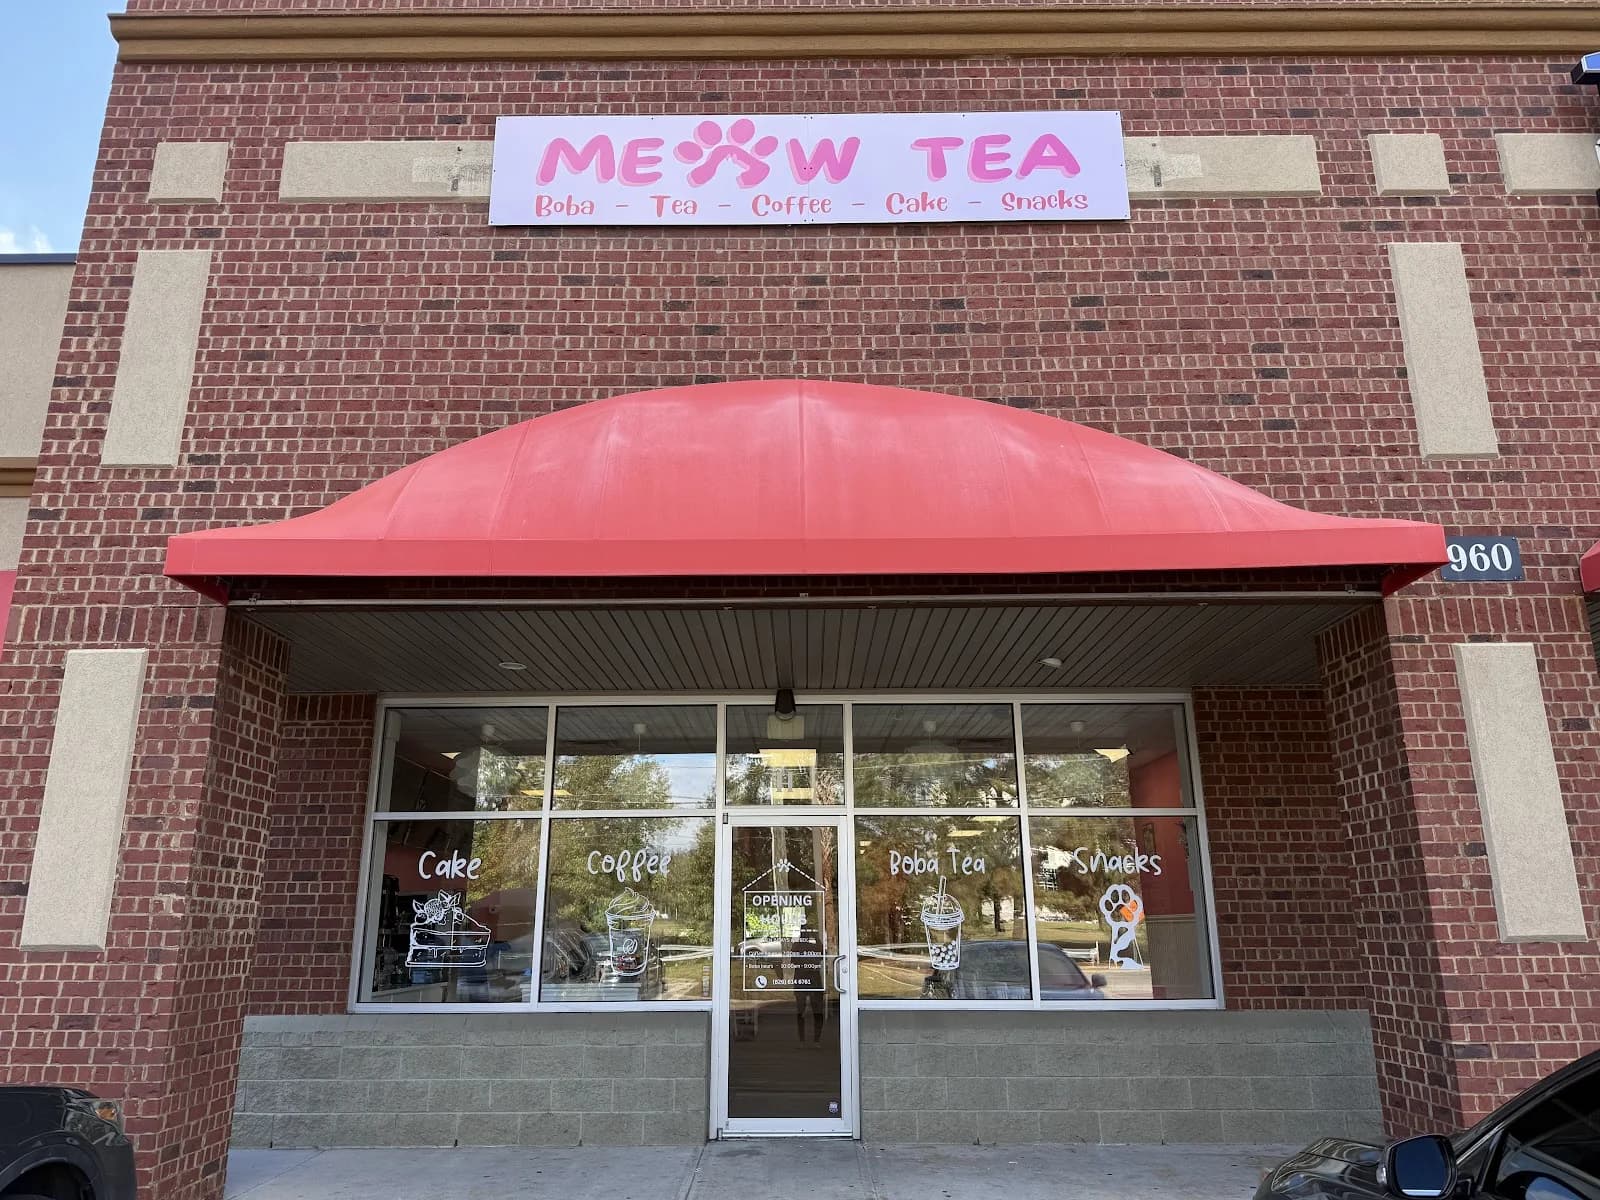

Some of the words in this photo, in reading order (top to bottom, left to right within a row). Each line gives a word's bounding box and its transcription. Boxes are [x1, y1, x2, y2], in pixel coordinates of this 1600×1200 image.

[911, 134, 1081, 183] TEA
[535, 195, 595, 218] Boba
[650, 196, 698, 218] Tea
[752, 195, 832, 217] Coffee
[886, 192, 948, 215] Cake
[1001, 190, 1088, 212] Snacks
[1446, 543, 1513, 572] 960
[418, 850, 482, 879] Cake
[587, 847, 672, 882] Coffee
[889, 849, 939, 876] Boba
[946, 847, 985, 875] Tea
[1073, 847, 1162, 876] Snacks
[752, 895, 813, 907] OPENING
